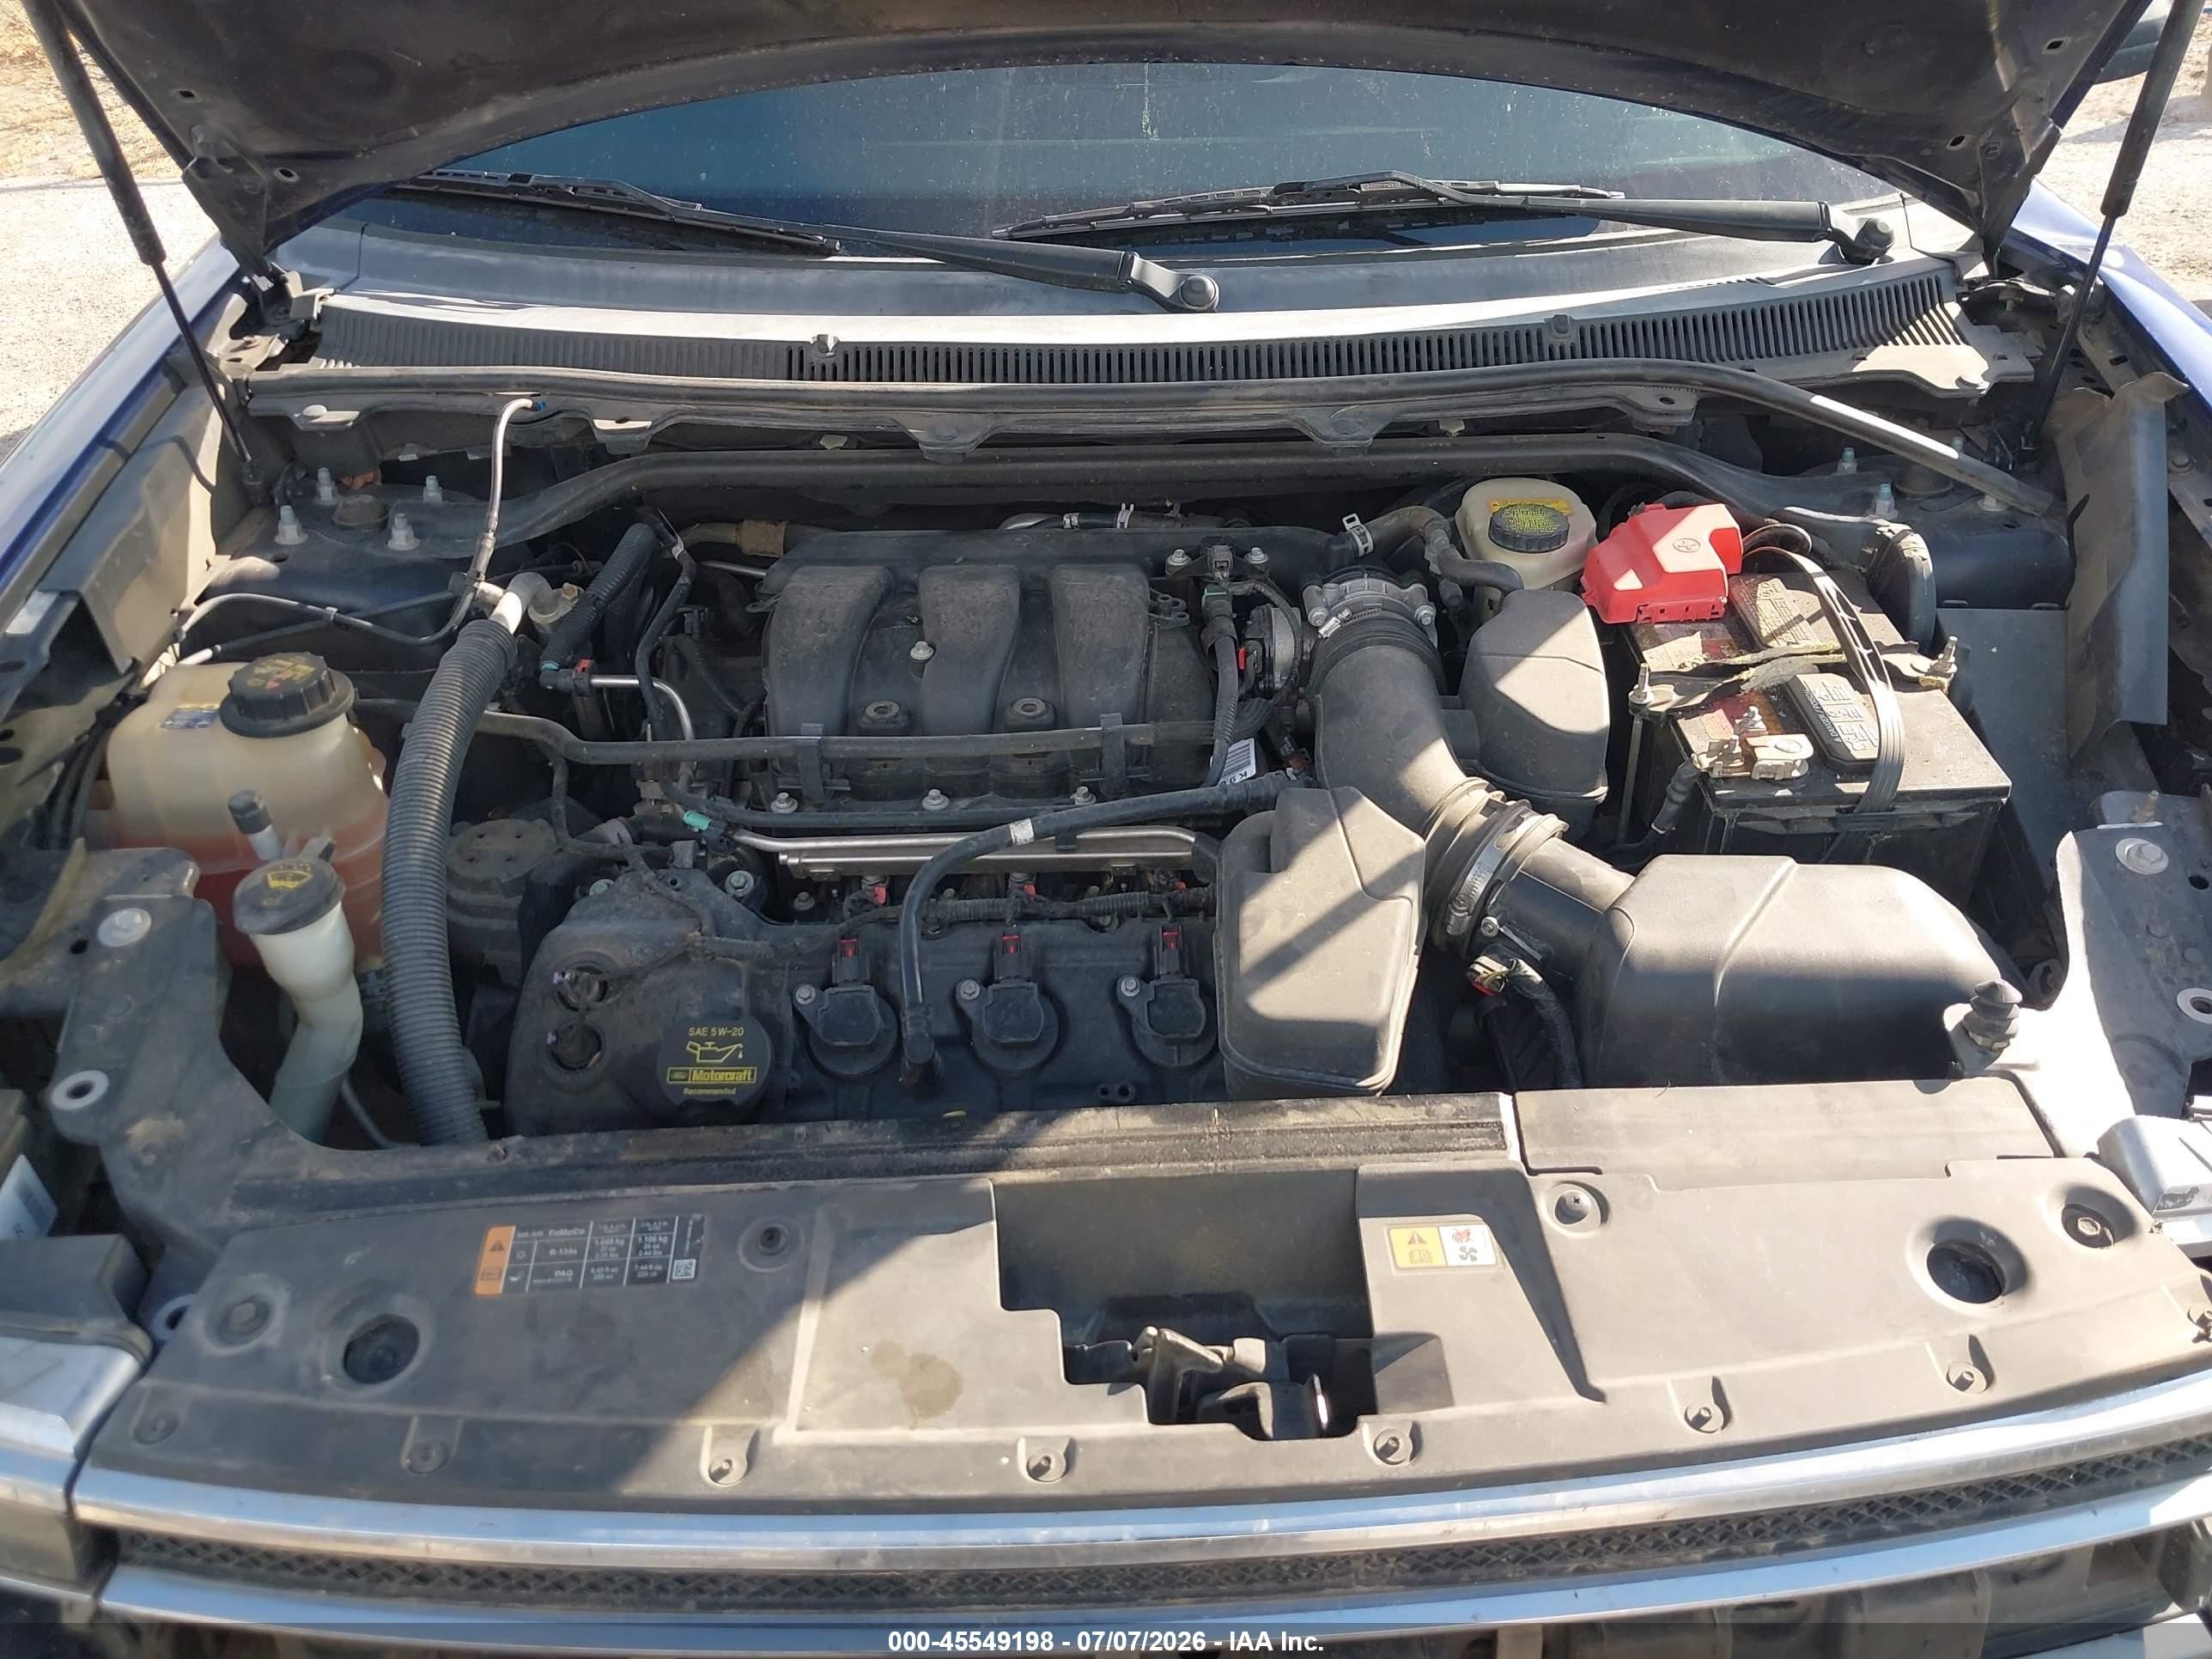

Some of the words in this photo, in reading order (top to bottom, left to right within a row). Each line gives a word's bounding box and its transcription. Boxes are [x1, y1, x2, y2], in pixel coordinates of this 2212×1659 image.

[688, 1027, 708, 1036] SAE
[710, 1026, 744, 1036] 5W-20
[692, 1069, 752, 1081] Motorcraft
